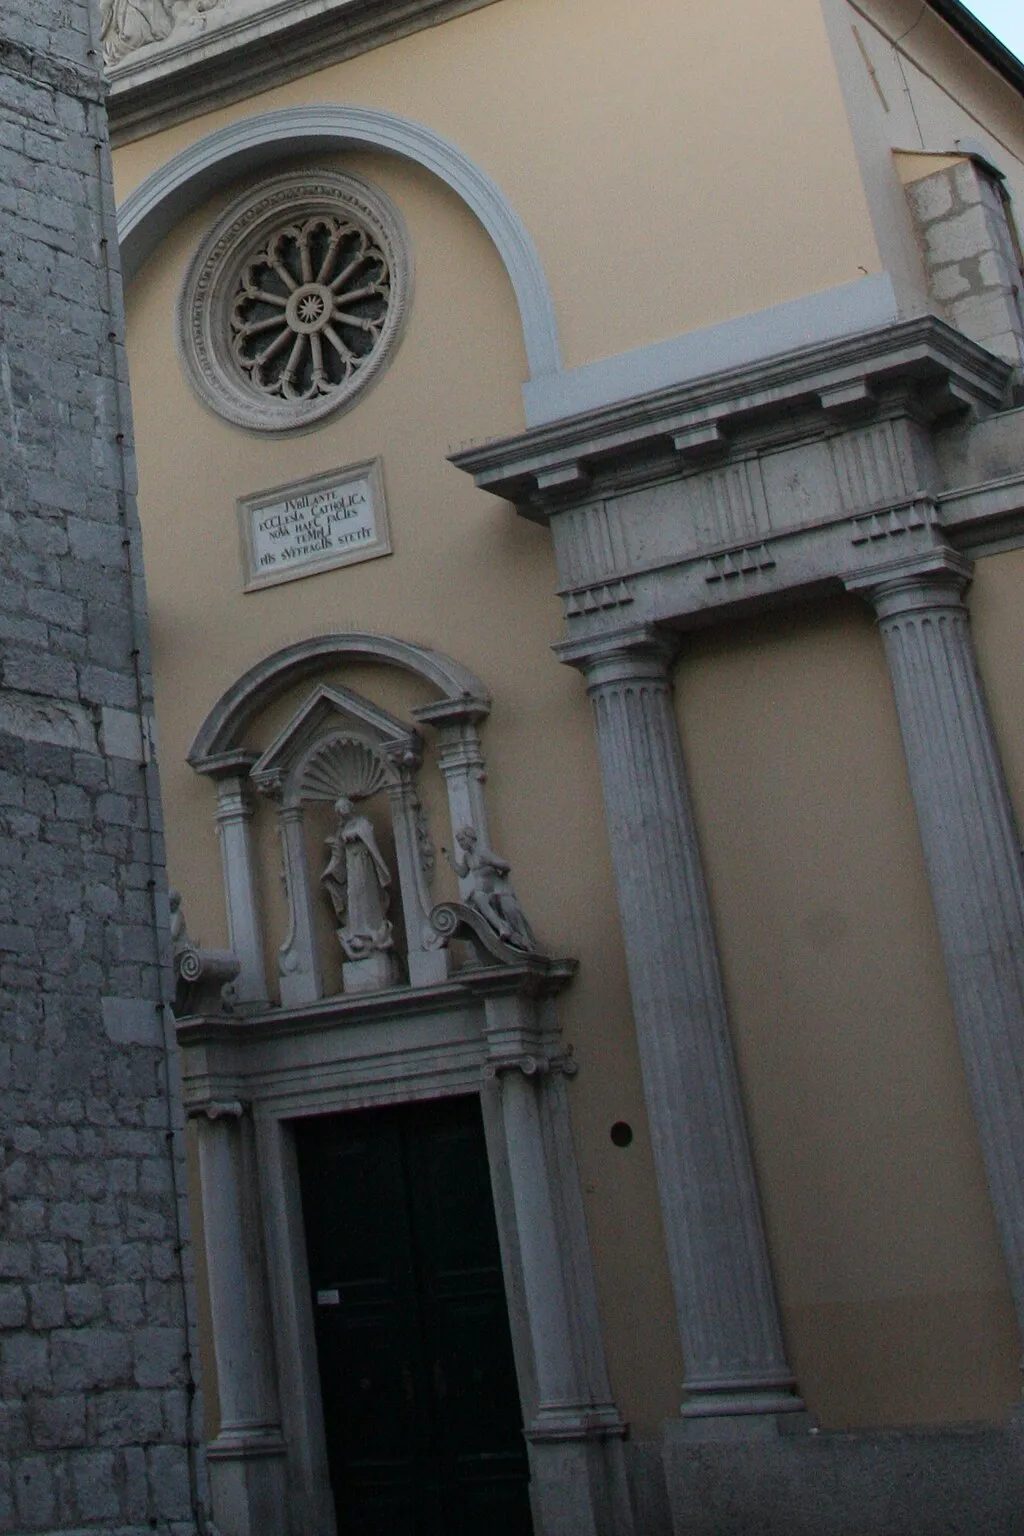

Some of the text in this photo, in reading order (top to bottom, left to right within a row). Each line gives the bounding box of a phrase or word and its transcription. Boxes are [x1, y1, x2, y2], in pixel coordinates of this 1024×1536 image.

[258, 493, 366, 532] ECCLESIA CATHOLICA
[269, 509, 358, 540] NOVA HAEC FACIES
[260, 552, 276, 566] PIIS
[339, 526, 372, 545] STETIT
[296, 525, 332, 545] TEMPLI
